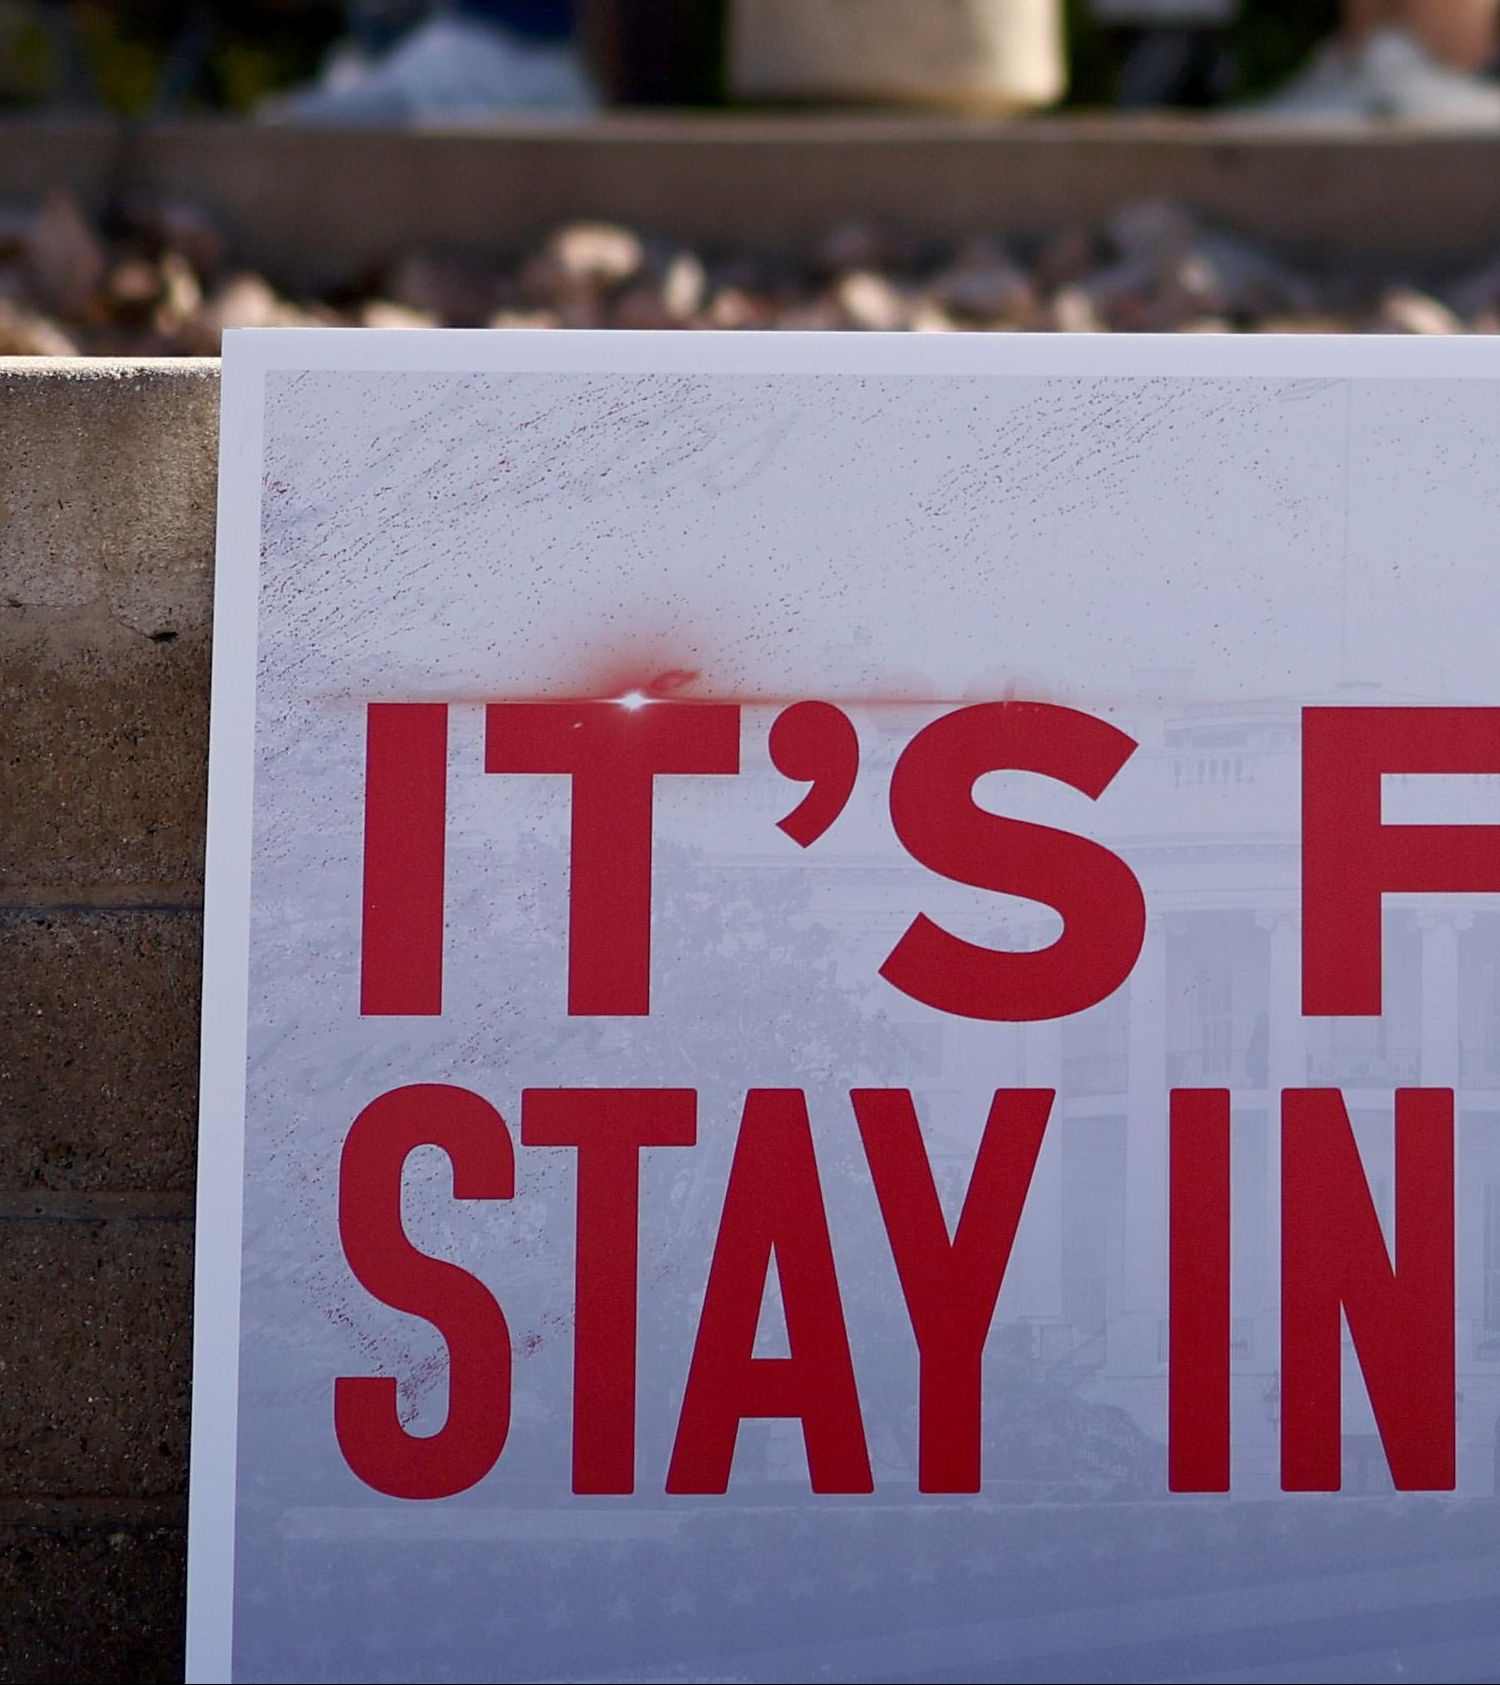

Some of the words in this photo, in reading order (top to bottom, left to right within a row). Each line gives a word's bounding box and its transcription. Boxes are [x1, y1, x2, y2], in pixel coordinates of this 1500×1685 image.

[359, 701, 1147, 1023] IT’S
[334, 1083, 1056, 1500] STAY
[1168, 1086, 1458, 1493] IN
